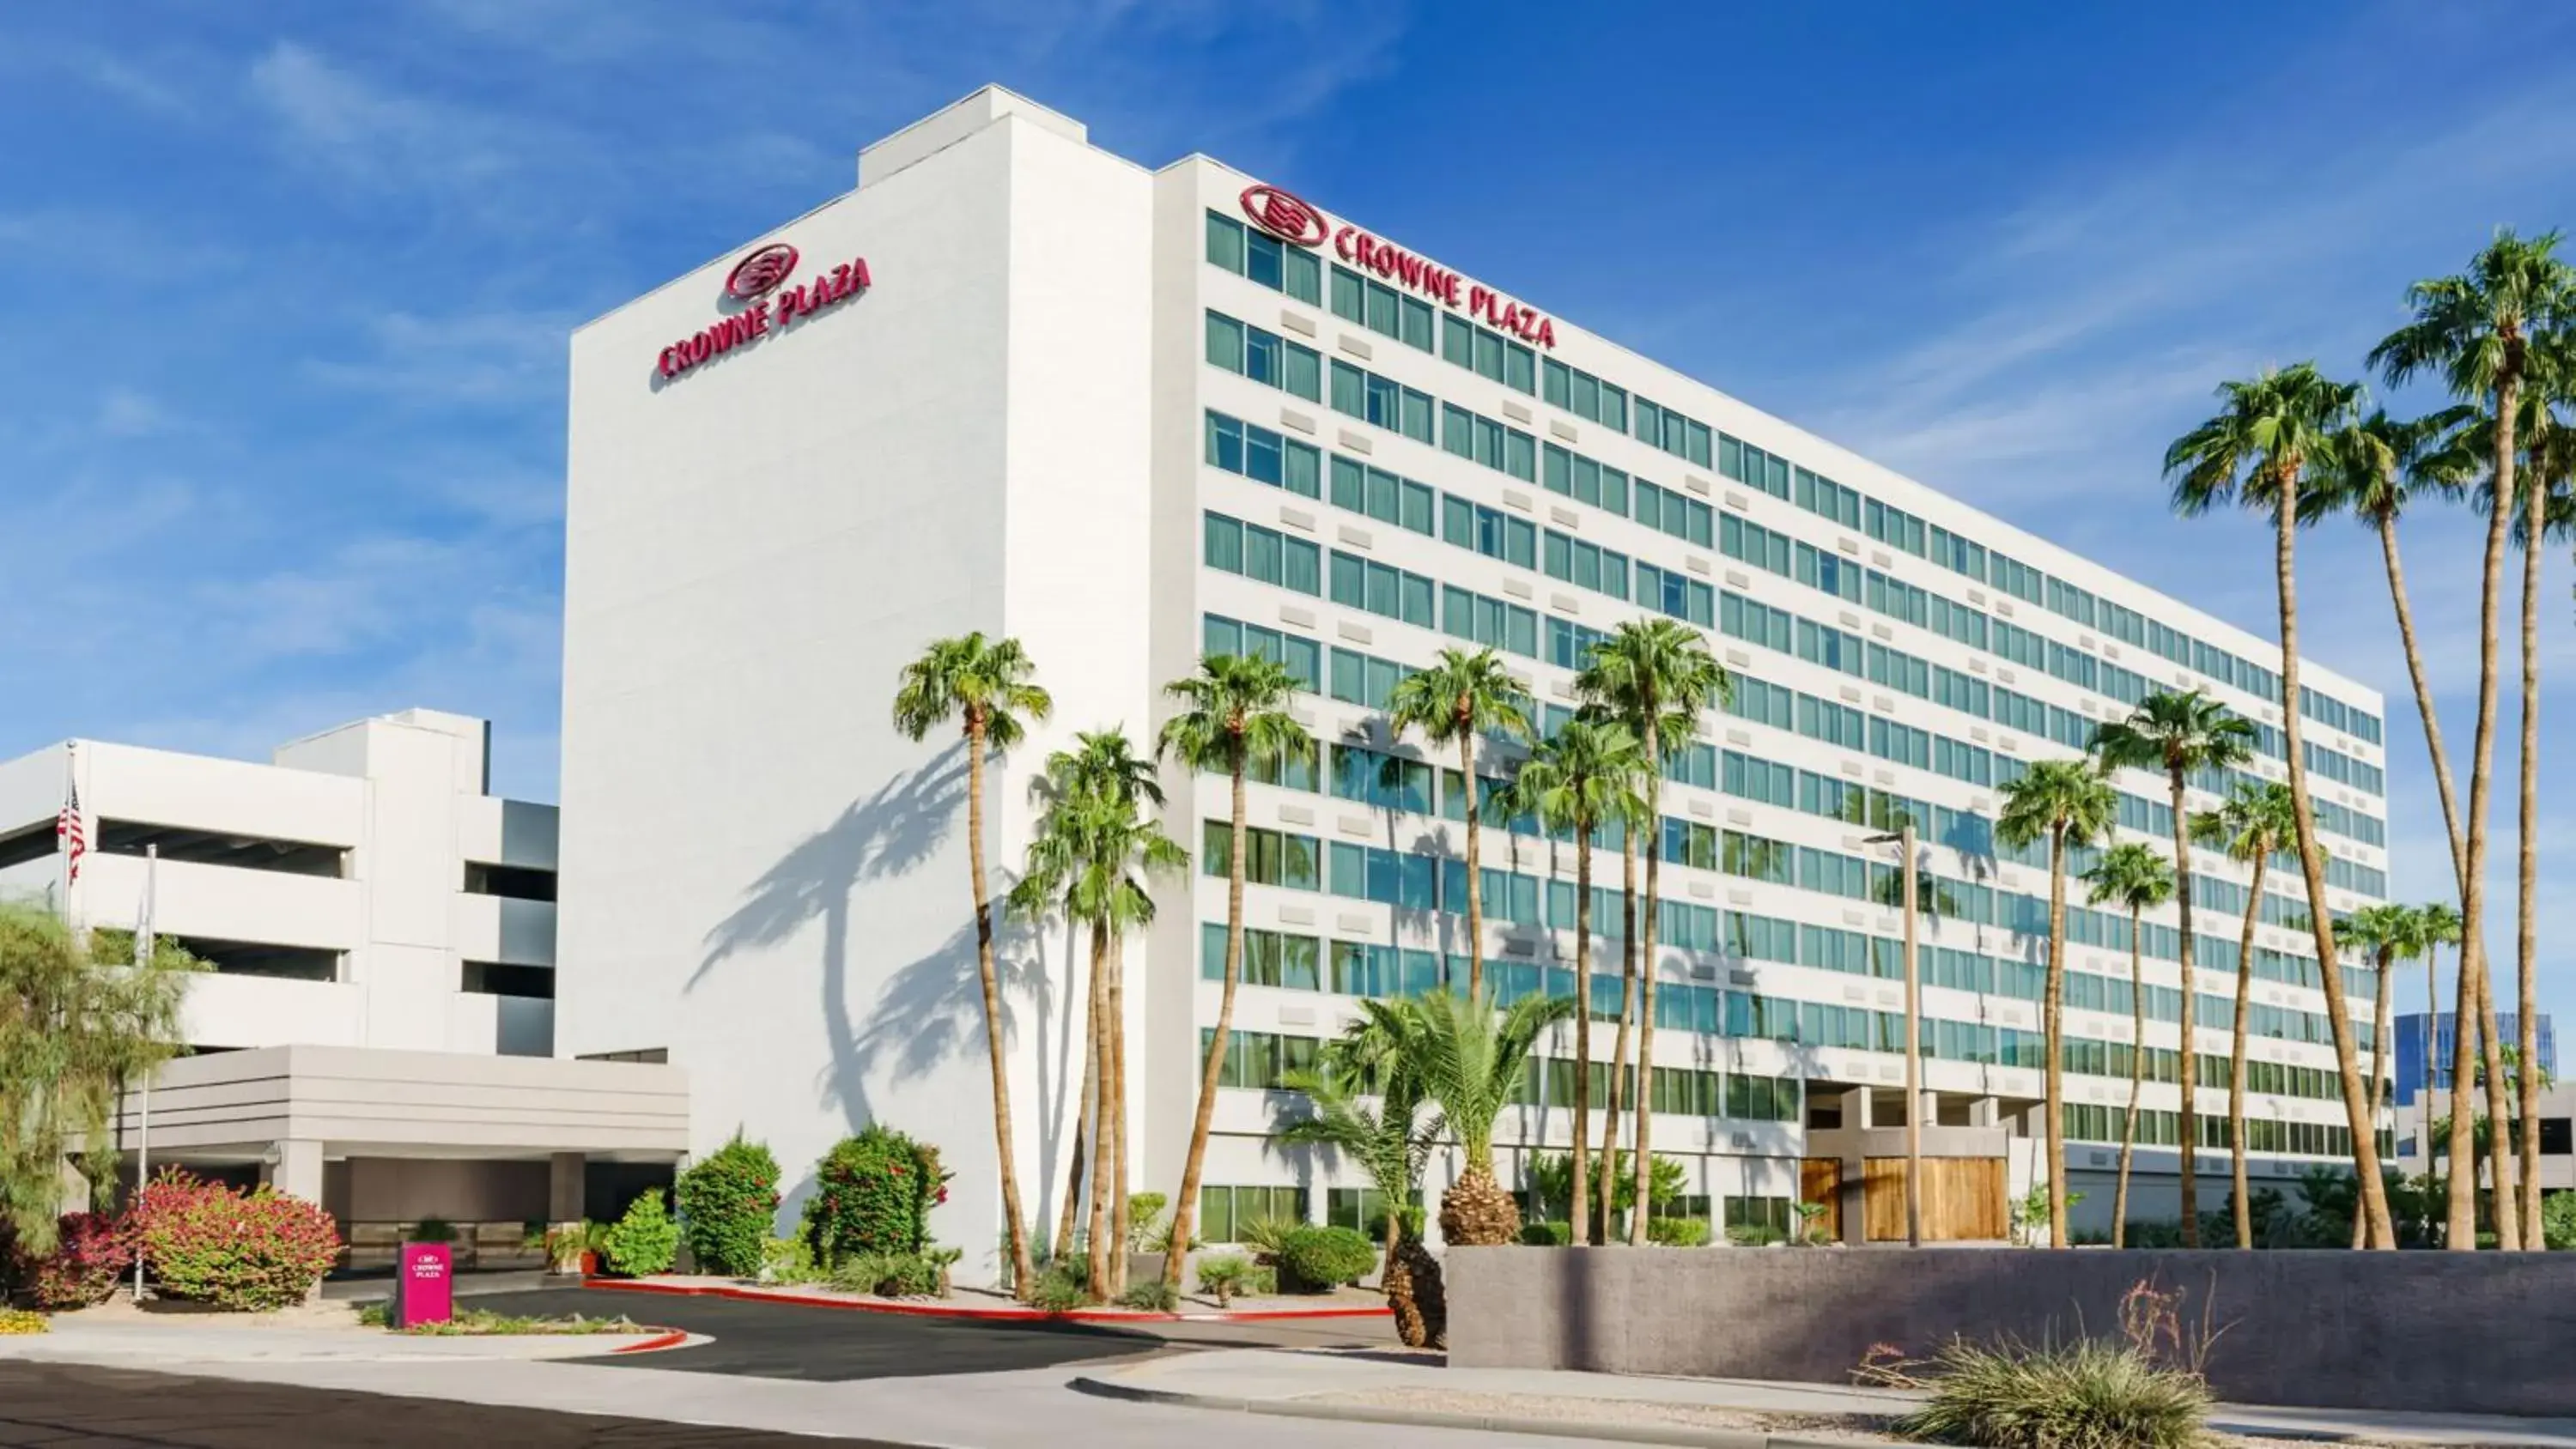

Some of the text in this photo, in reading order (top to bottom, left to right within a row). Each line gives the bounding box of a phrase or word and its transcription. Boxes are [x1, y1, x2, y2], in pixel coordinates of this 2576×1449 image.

[659, 257, 871, 378] CROWNE PLAZA
[1335, 226, 1557, 350] CROWNE PLAZA
